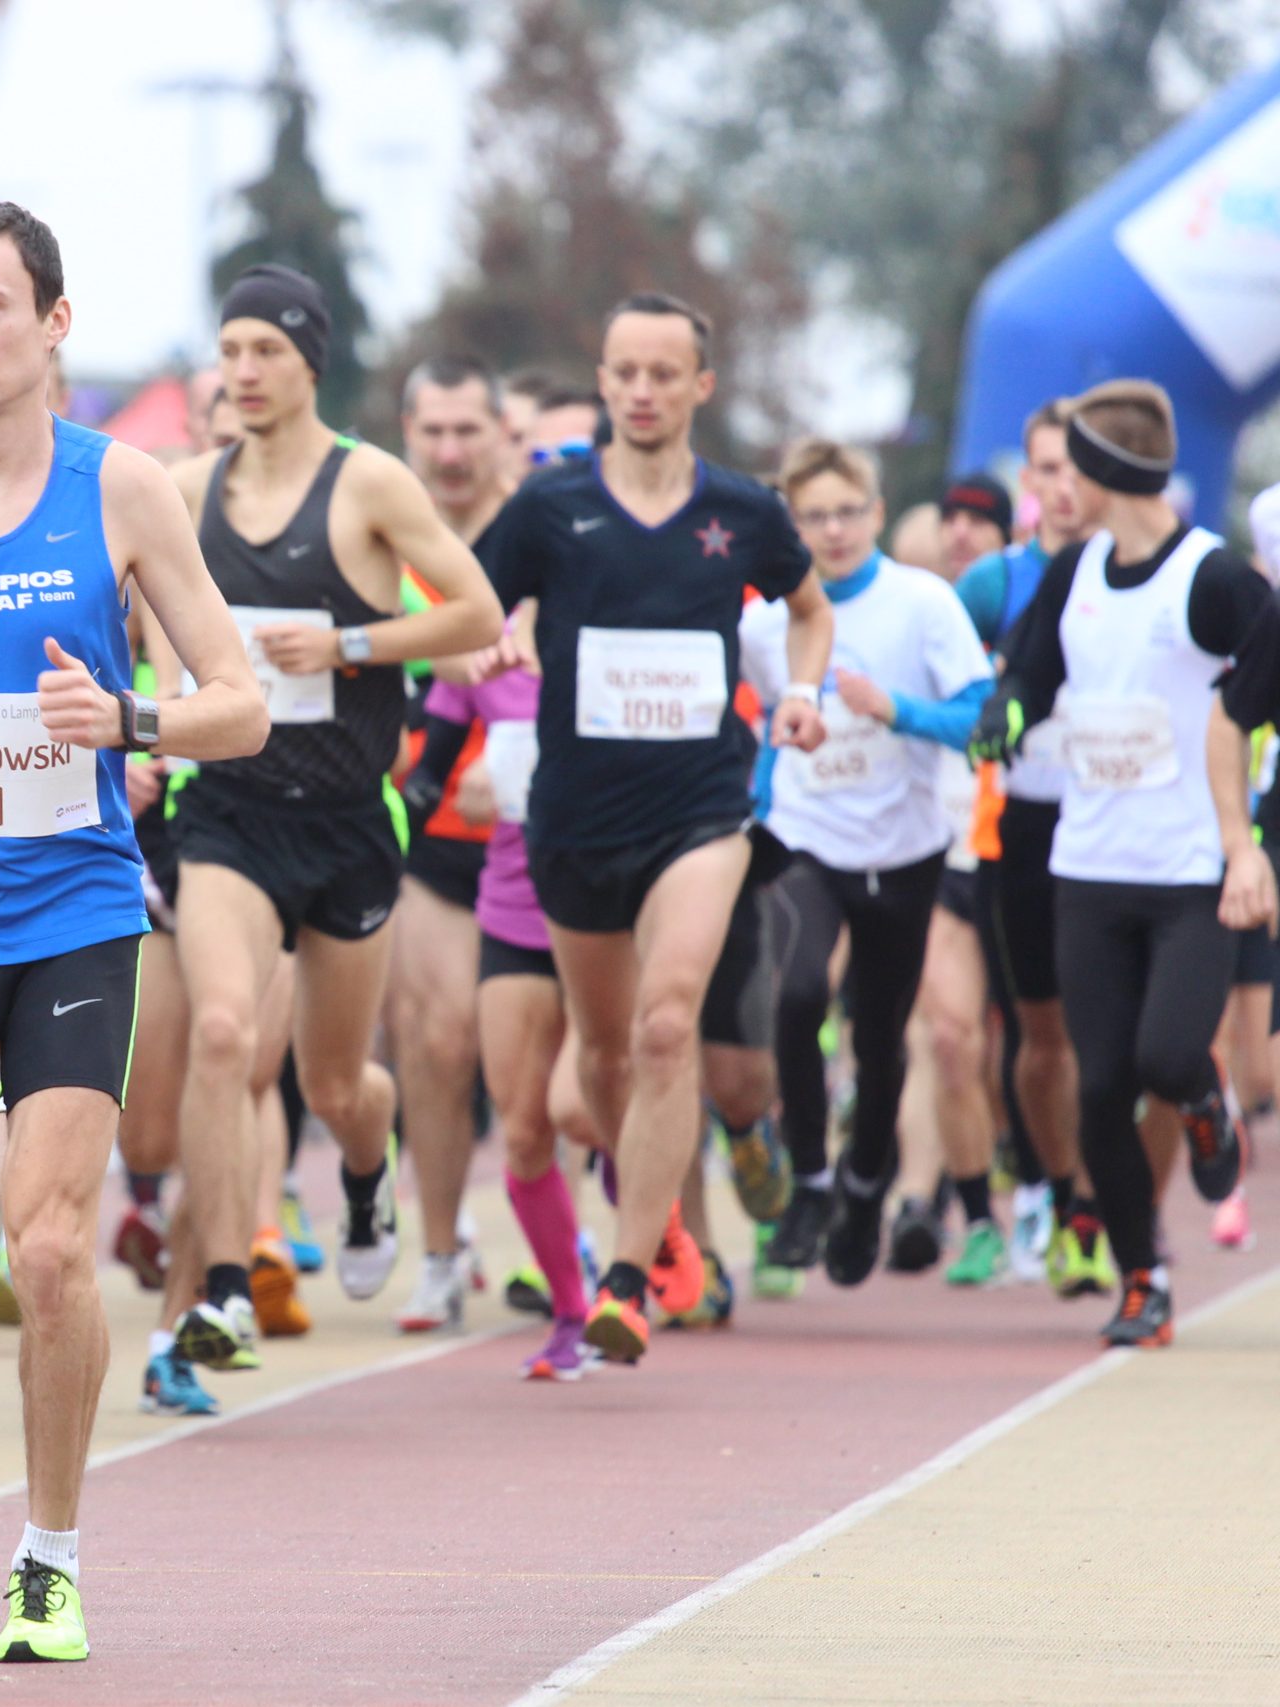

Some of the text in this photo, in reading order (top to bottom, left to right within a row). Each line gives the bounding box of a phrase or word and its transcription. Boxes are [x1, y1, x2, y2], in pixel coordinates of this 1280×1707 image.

[39, 591, 75, 602] team
[1, 708, 8, 719] o
[622, 698, 685, 730] 1018
